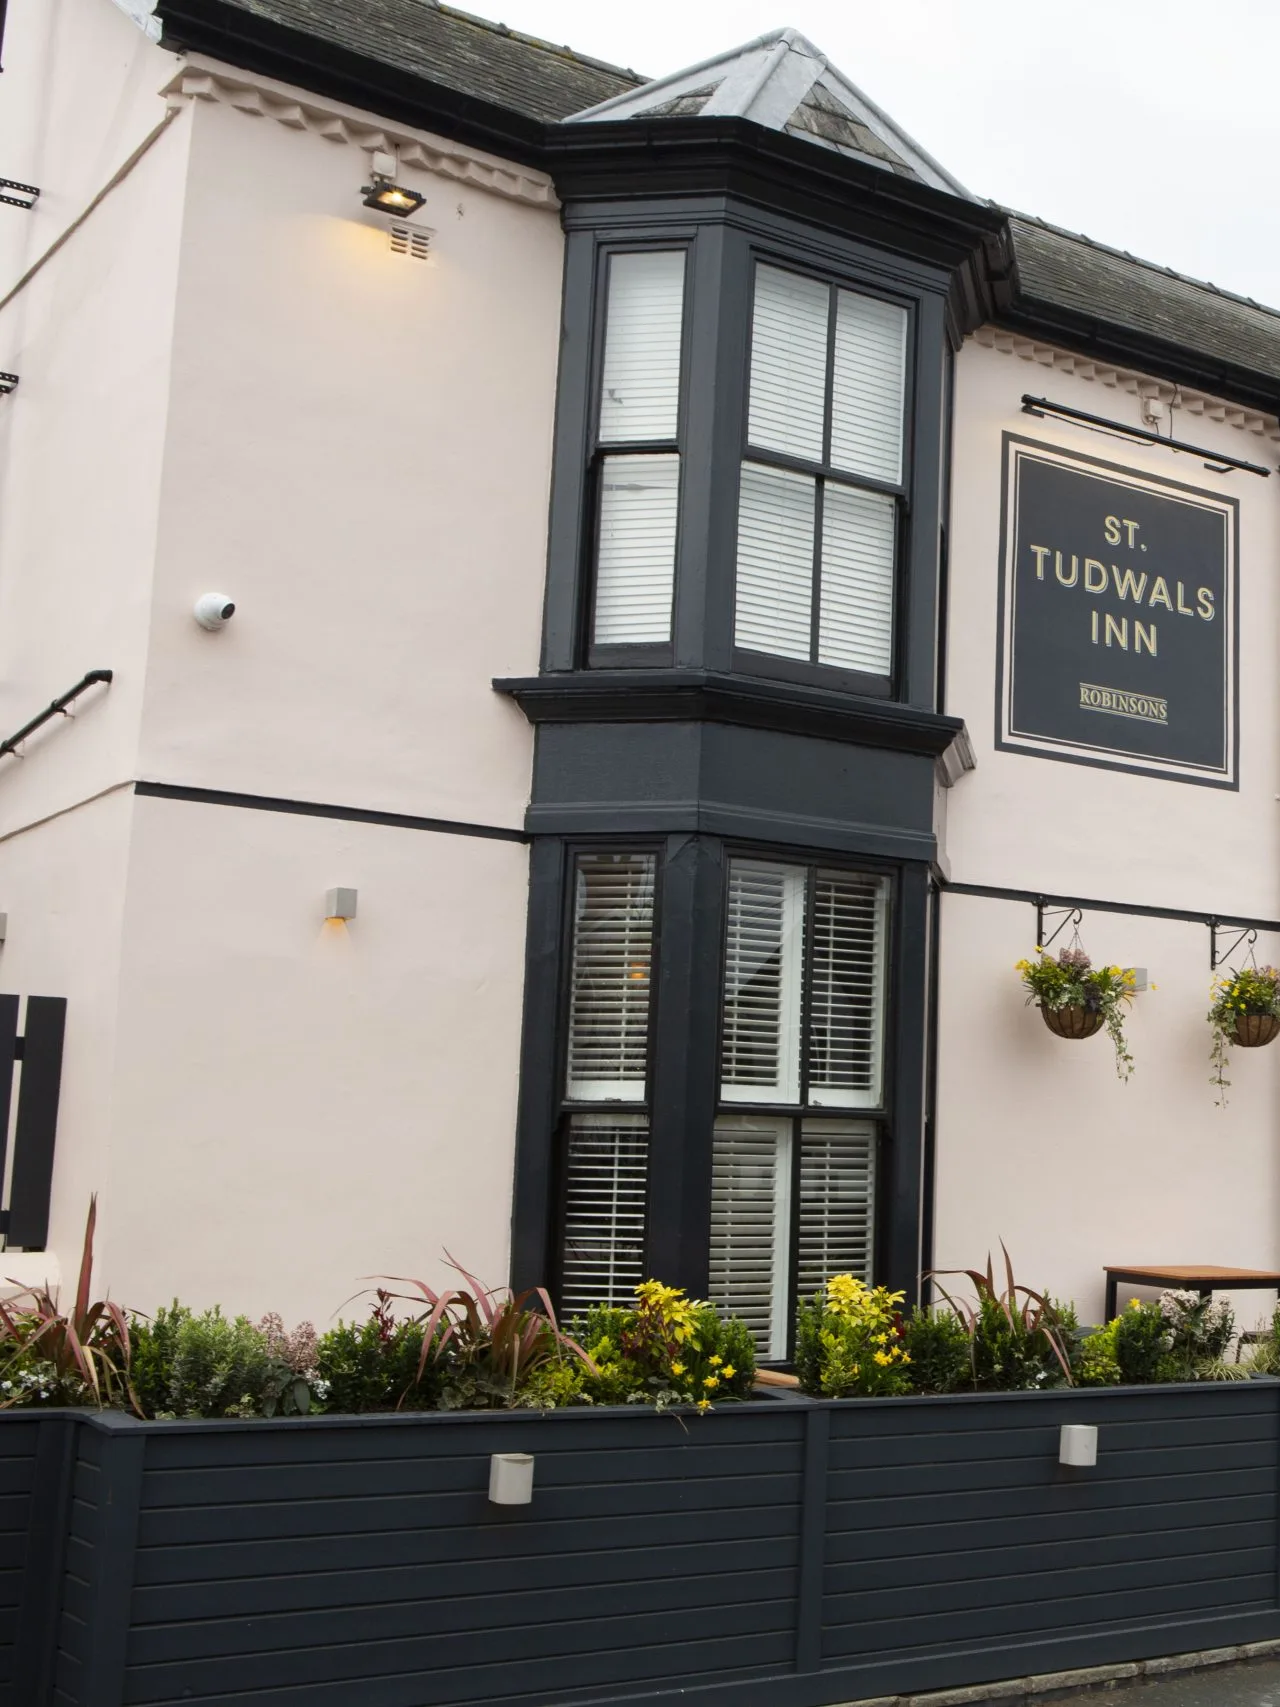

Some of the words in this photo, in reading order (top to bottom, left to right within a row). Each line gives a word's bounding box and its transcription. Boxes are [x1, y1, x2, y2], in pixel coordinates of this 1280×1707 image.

[1104, 515, 1147, 551] ST.
[1030, 544, 1215, 621] TUDWALS
[1091, 610, 1157, 656] INN
[1080, 687, 1167, 719] ROBINSONS
